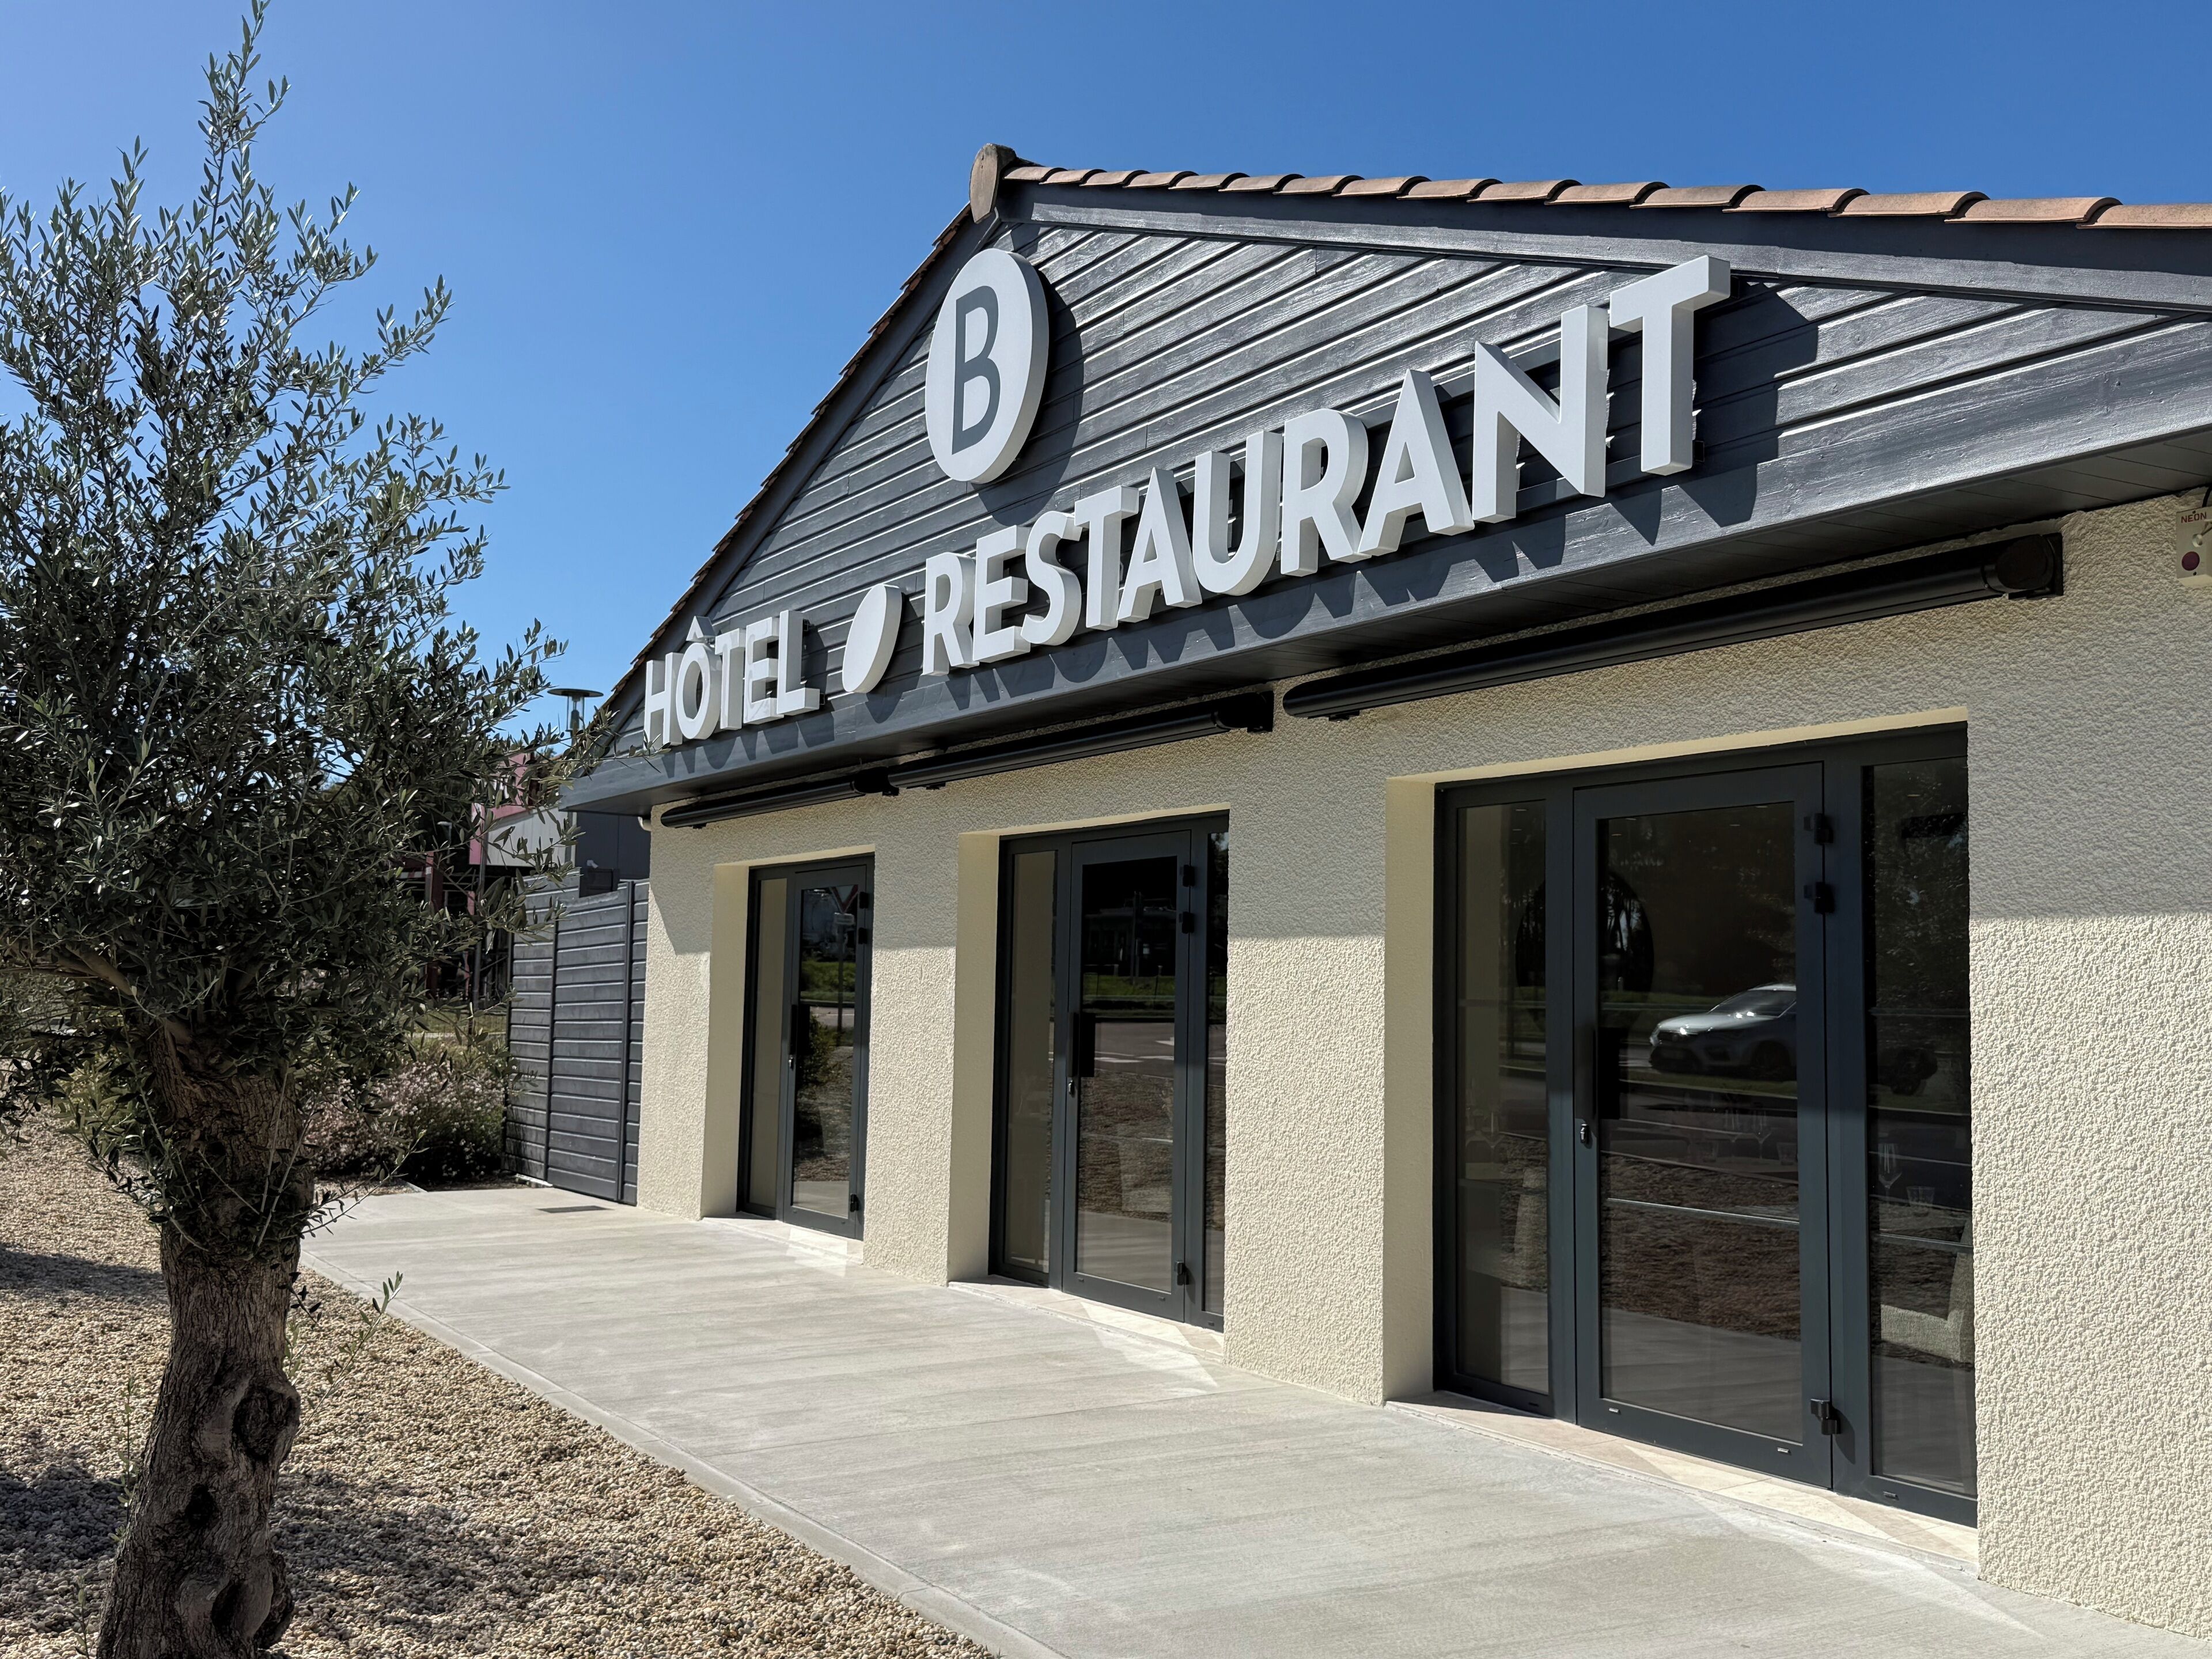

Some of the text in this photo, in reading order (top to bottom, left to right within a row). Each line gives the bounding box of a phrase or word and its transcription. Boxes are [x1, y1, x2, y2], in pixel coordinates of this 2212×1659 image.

[643, 255, 1730, 748] HÔTEL RESTAURANT
[952, 285, 1001, 455] B
